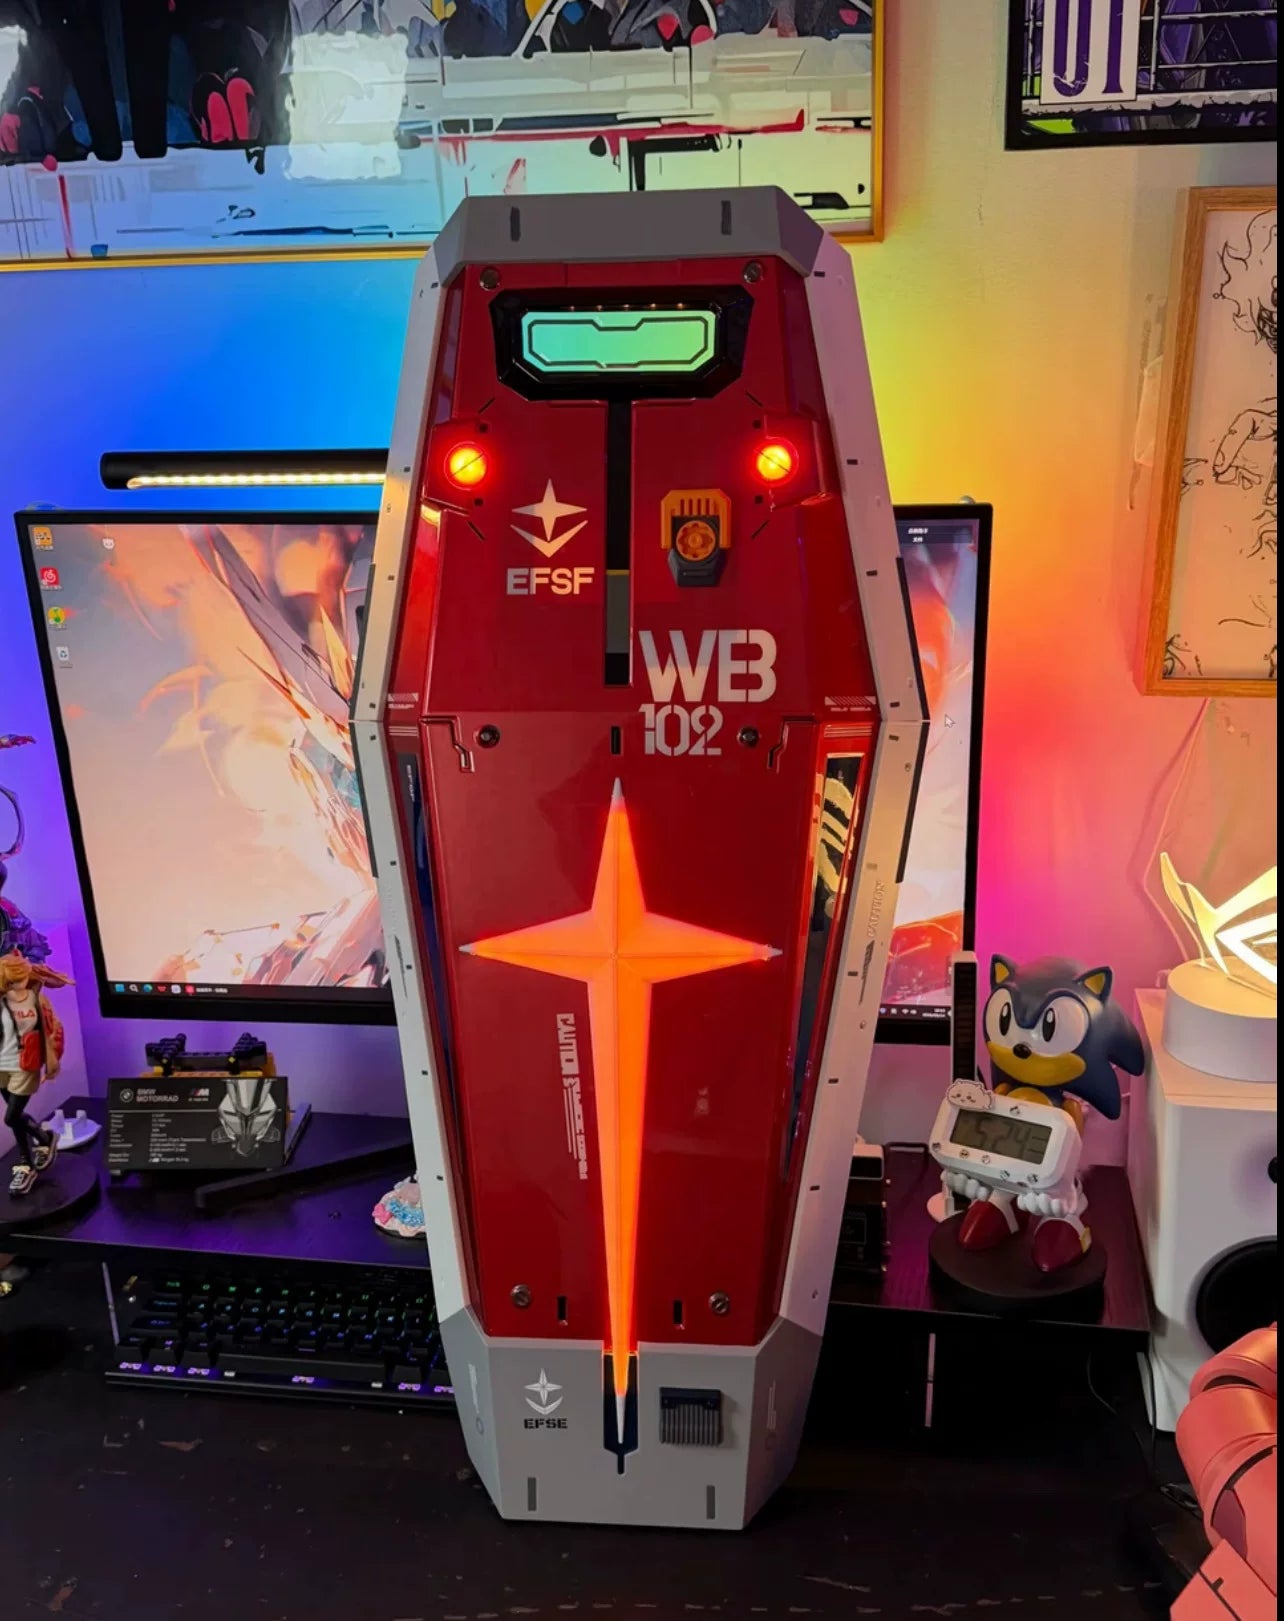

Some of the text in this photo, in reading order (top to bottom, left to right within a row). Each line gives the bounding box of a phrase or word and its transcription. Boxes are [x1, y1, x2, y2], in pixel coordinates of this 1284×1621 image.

[506, 567, 595, 595] EFSF
[638, 629, 777, 703] WB
[638, 703, 724, 757] 102
[136, 1095, 179, 1103] MOTORRAD
[523, 1417, 569, 1429] EFSE
